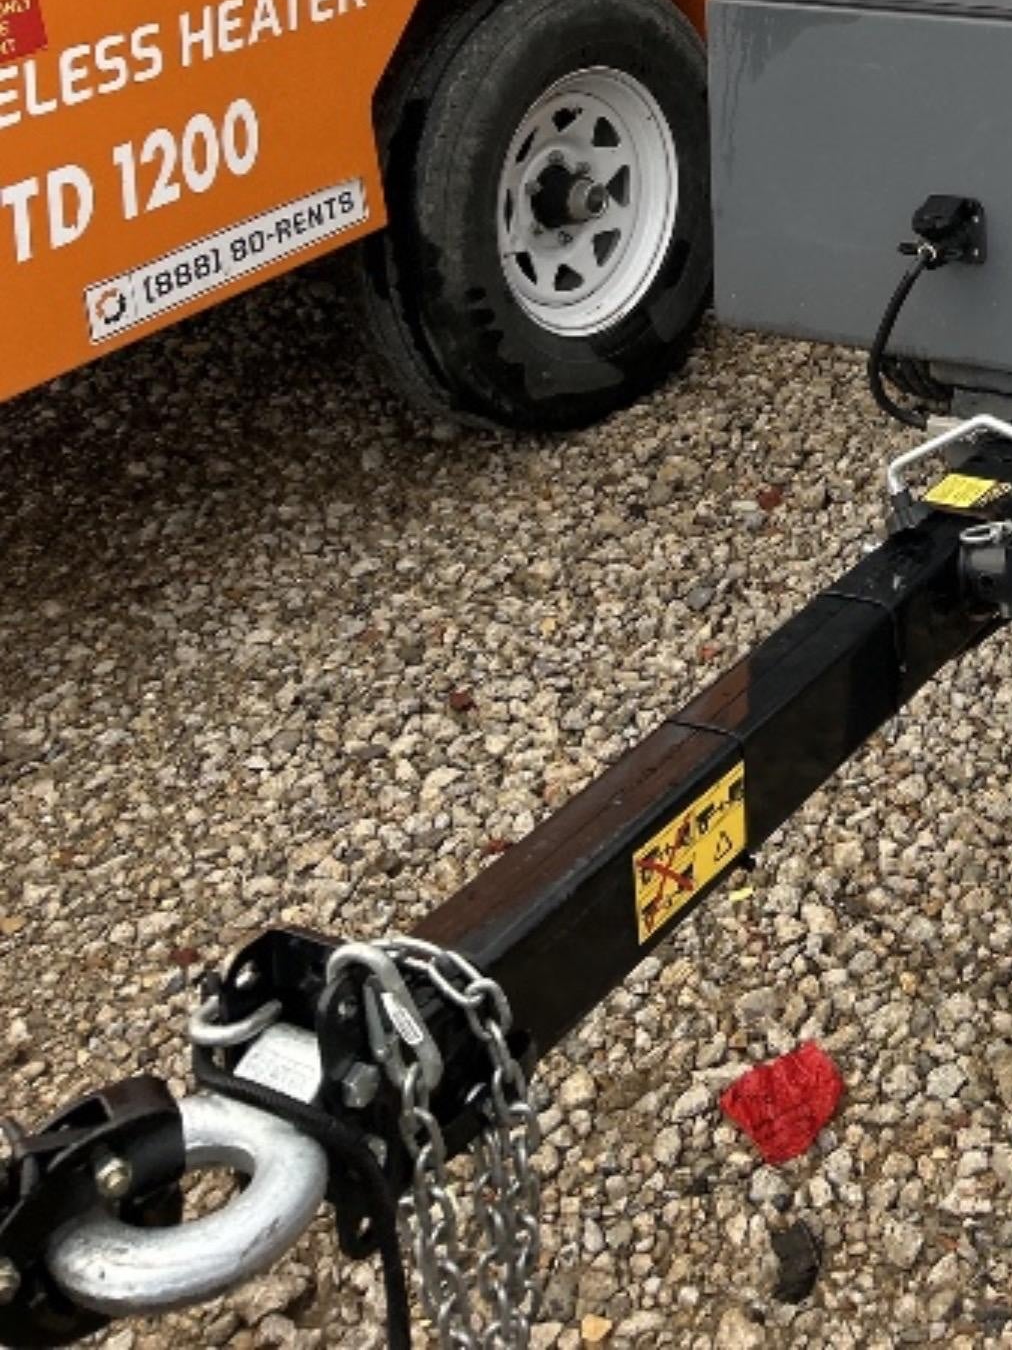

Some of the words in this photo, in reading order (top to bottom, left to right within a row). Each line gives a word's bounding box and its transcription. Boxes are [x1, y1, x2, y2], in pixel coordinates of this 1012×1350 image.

[112, 97, 260, 220] 1200
[142, 248, 223, 304] (888)
[229, 190, 355, 263] 80-RENTS
